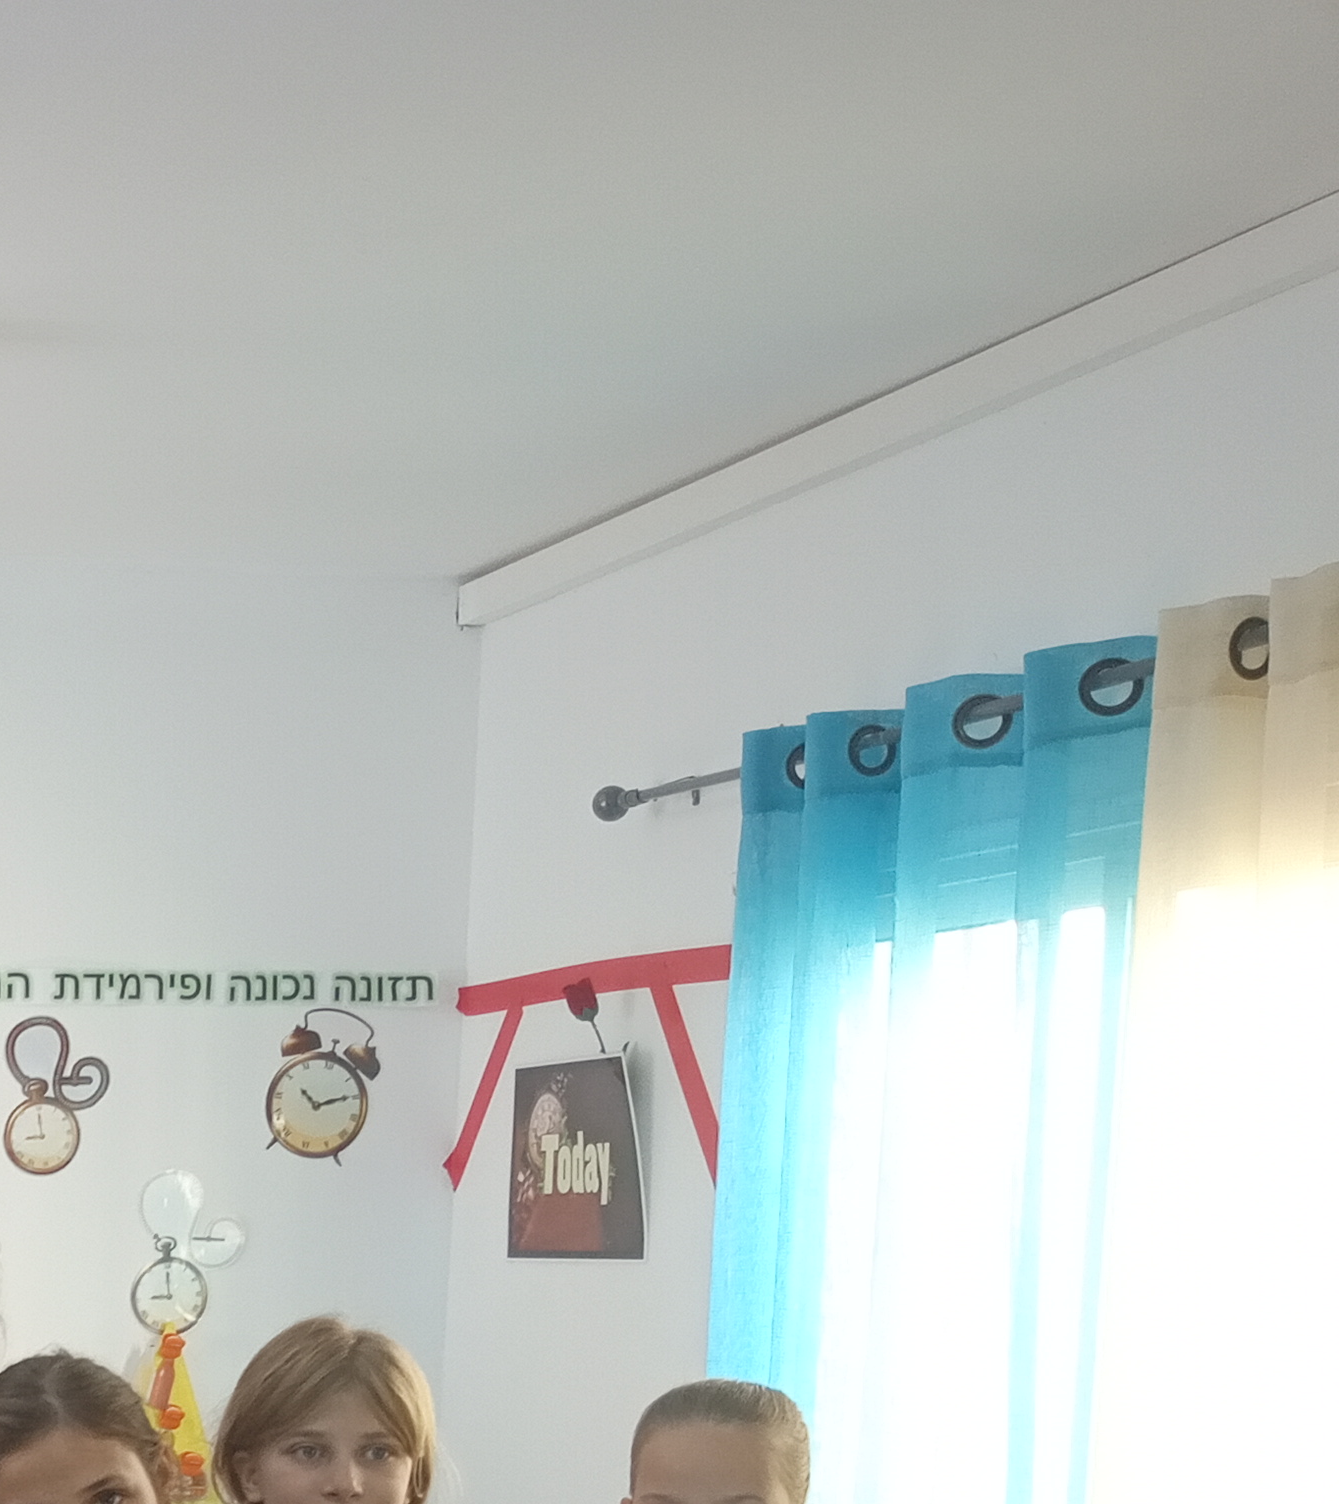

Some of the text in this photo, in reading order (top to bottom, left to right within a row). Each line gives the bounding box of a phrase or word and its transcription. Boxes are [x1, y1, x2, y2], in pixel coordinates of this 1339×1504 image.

[53, 973, 213, 1001] ופירמידת
[229, 974, 316, 1002] נכונה
[333, 975, 434, 1002] תזונה
[540, 1130, 611, 1206] Today
